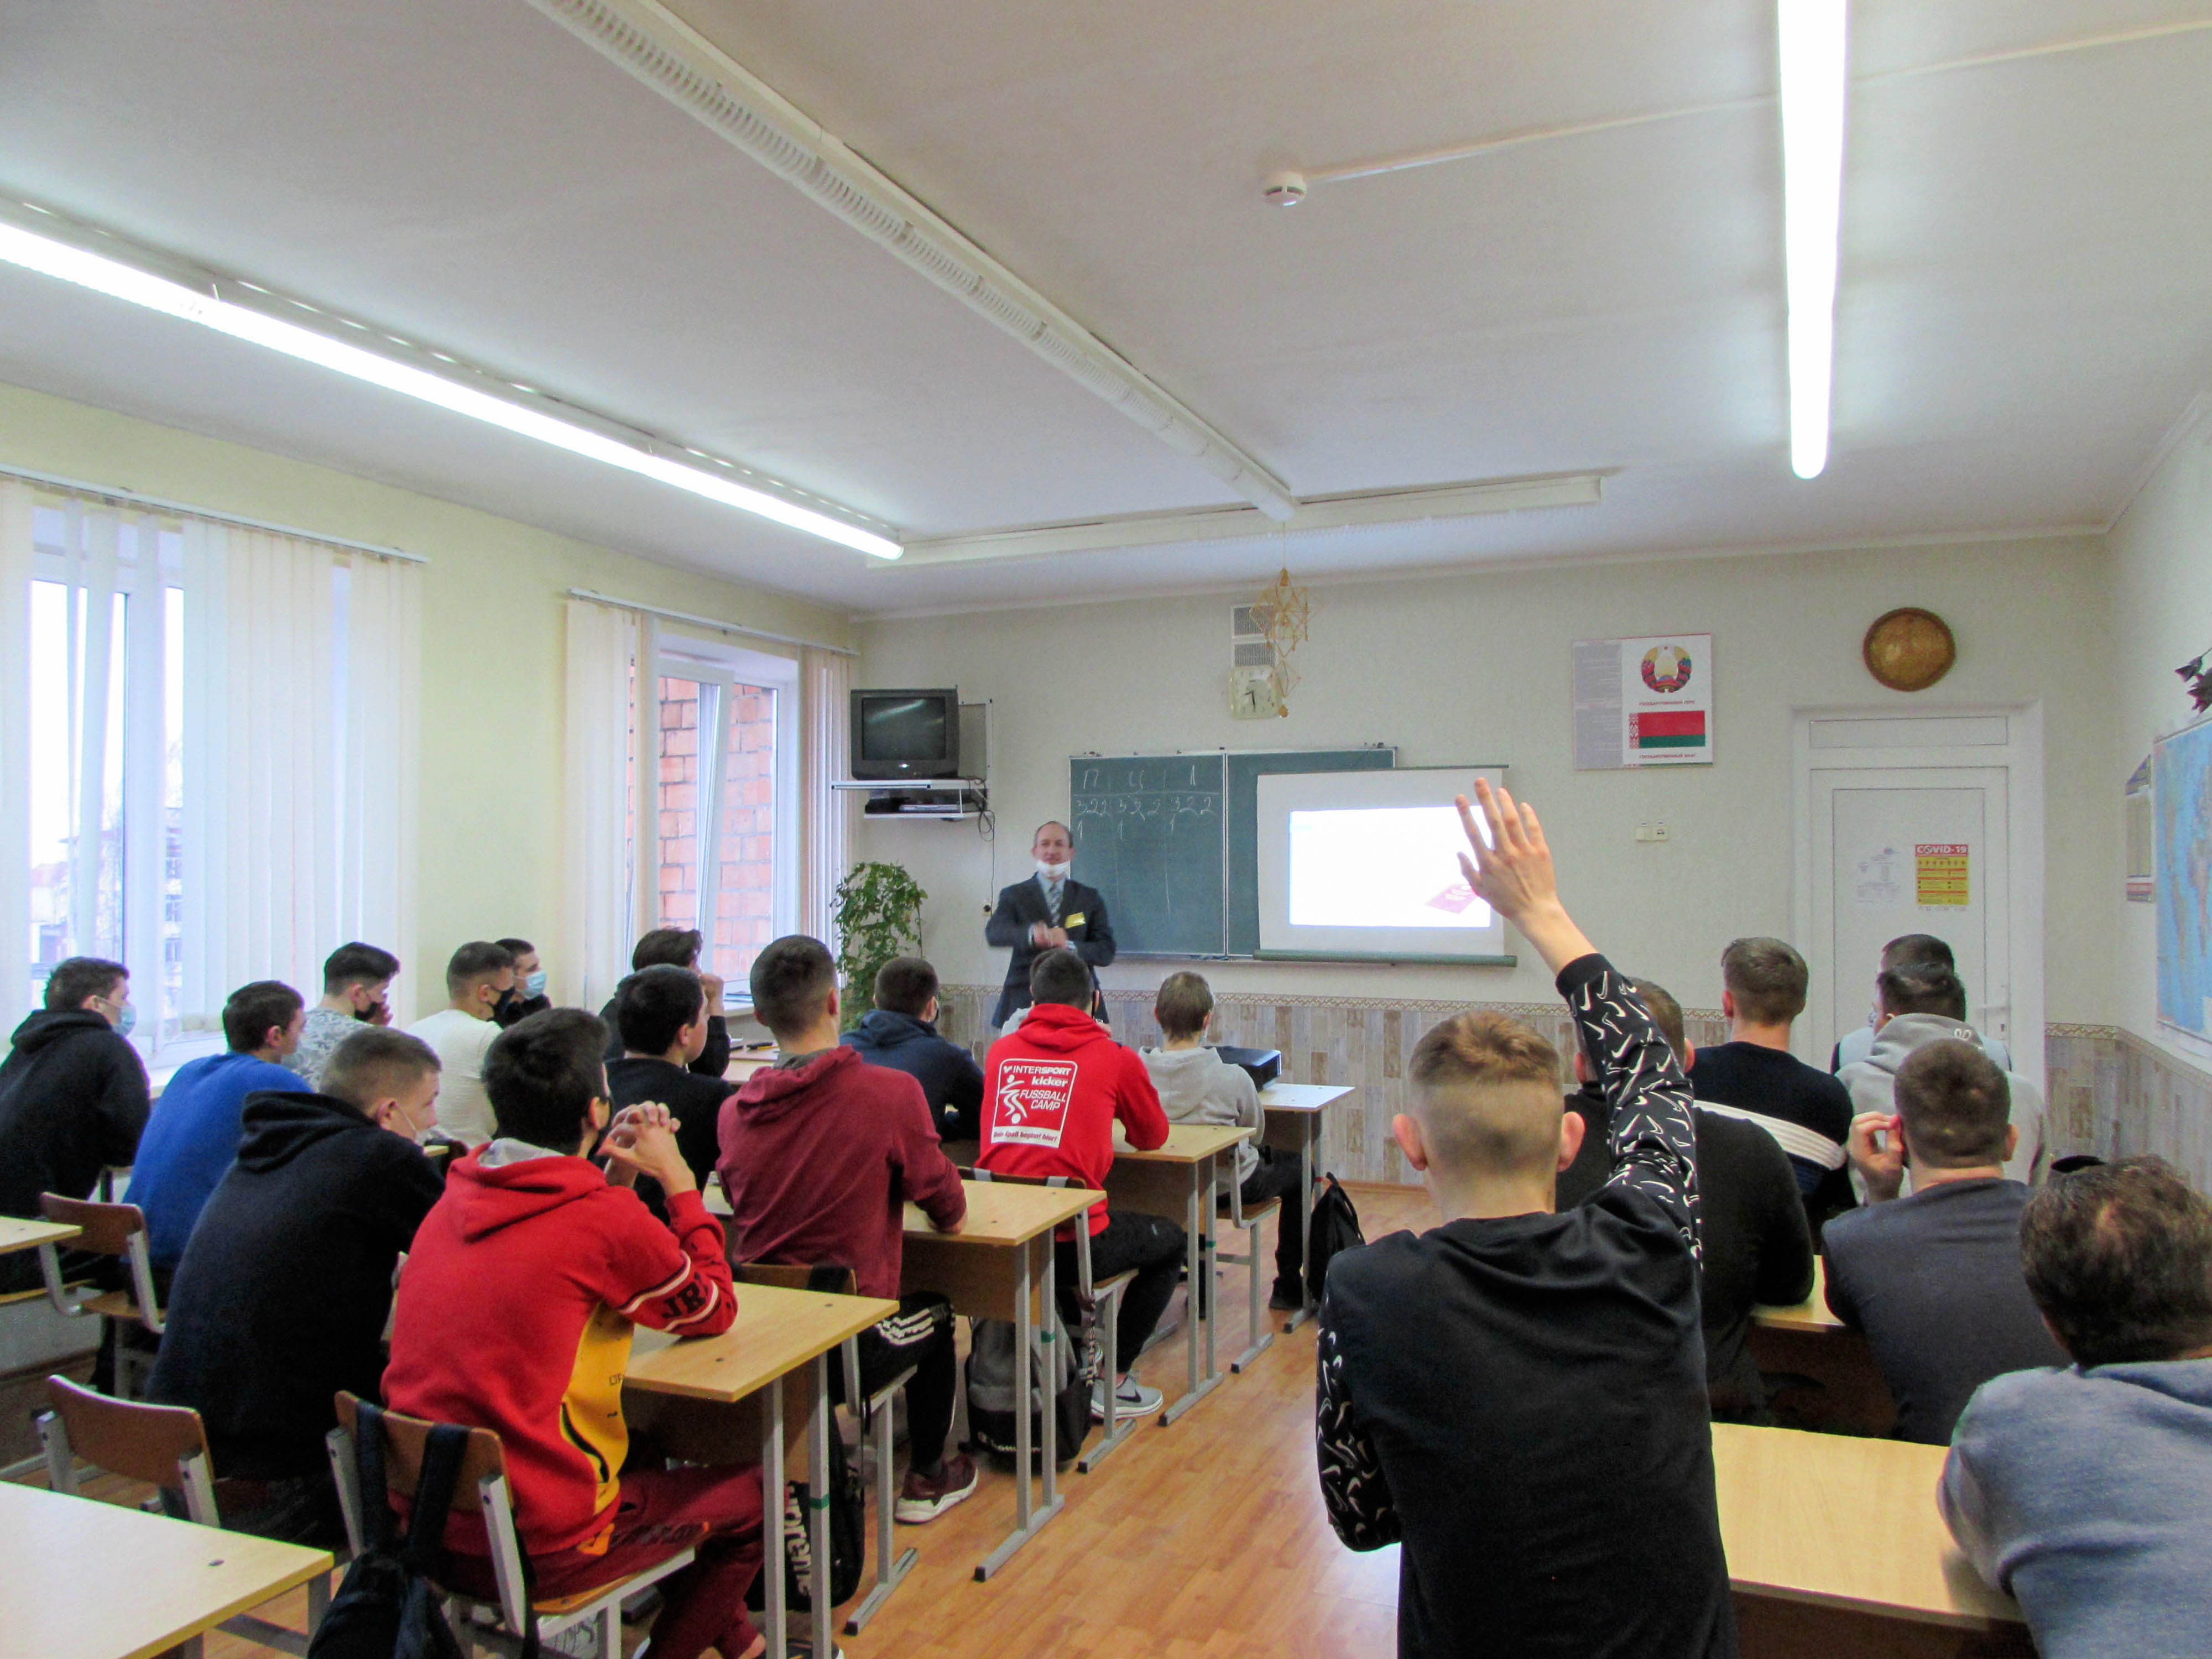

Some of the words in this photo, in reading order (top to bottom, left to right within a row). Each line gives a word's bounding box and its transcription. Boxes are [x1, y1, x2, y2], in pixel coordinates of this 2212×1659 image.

[1013, 1065, 1072, 1076] INTERSPORT
[1031, 1076, 1068, 1087] kicker
[1019, 1089, 1067, 1102] FUSSBALL
[1030, 1099, 1061, 1111] CAMP
